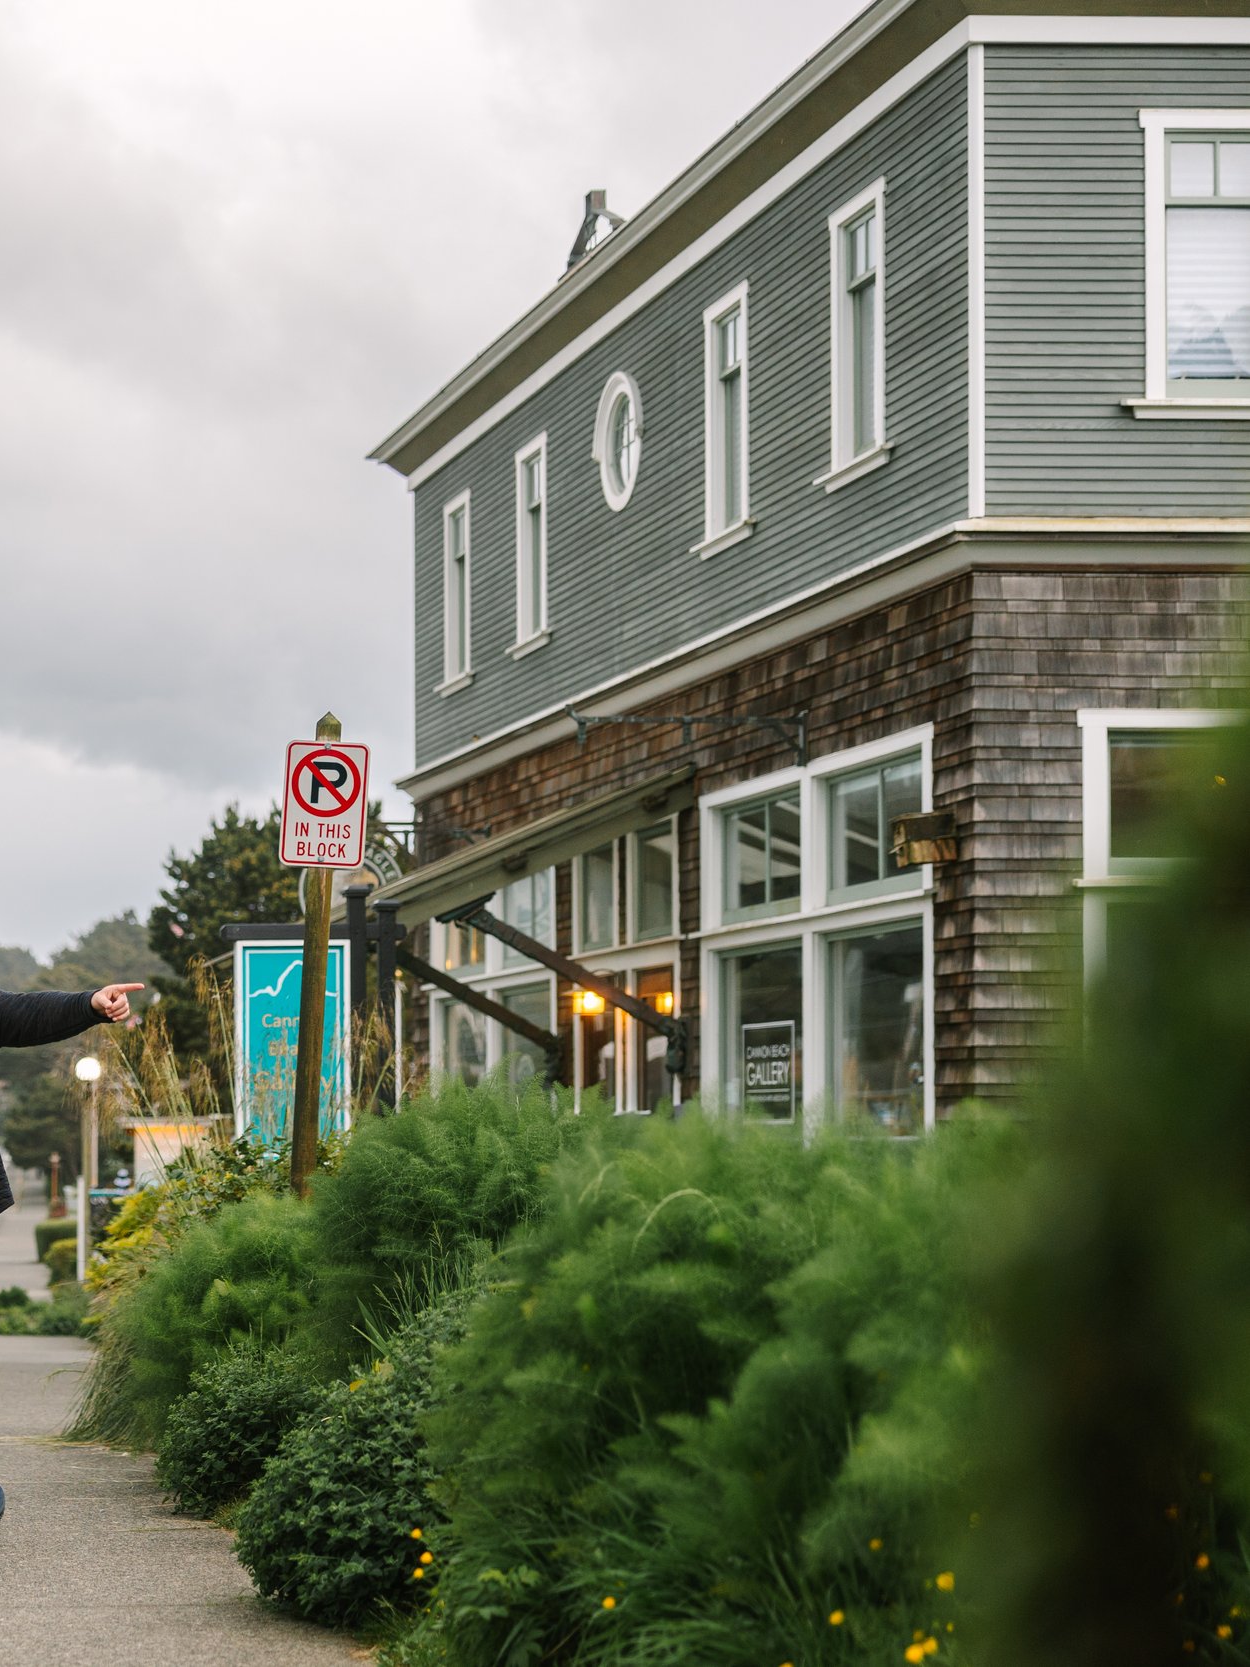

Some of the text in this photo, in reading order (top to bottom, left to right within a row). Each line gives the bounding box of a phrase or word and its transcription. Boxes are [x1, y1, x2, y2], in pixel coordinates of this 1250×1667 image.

[295, 822, 351, 840] IN THIS
[296, 841, 346, 859] BLOCK
[261, 1013, 300, 1028] Cann
[746, 1060, 790, 1087] GALLERY
